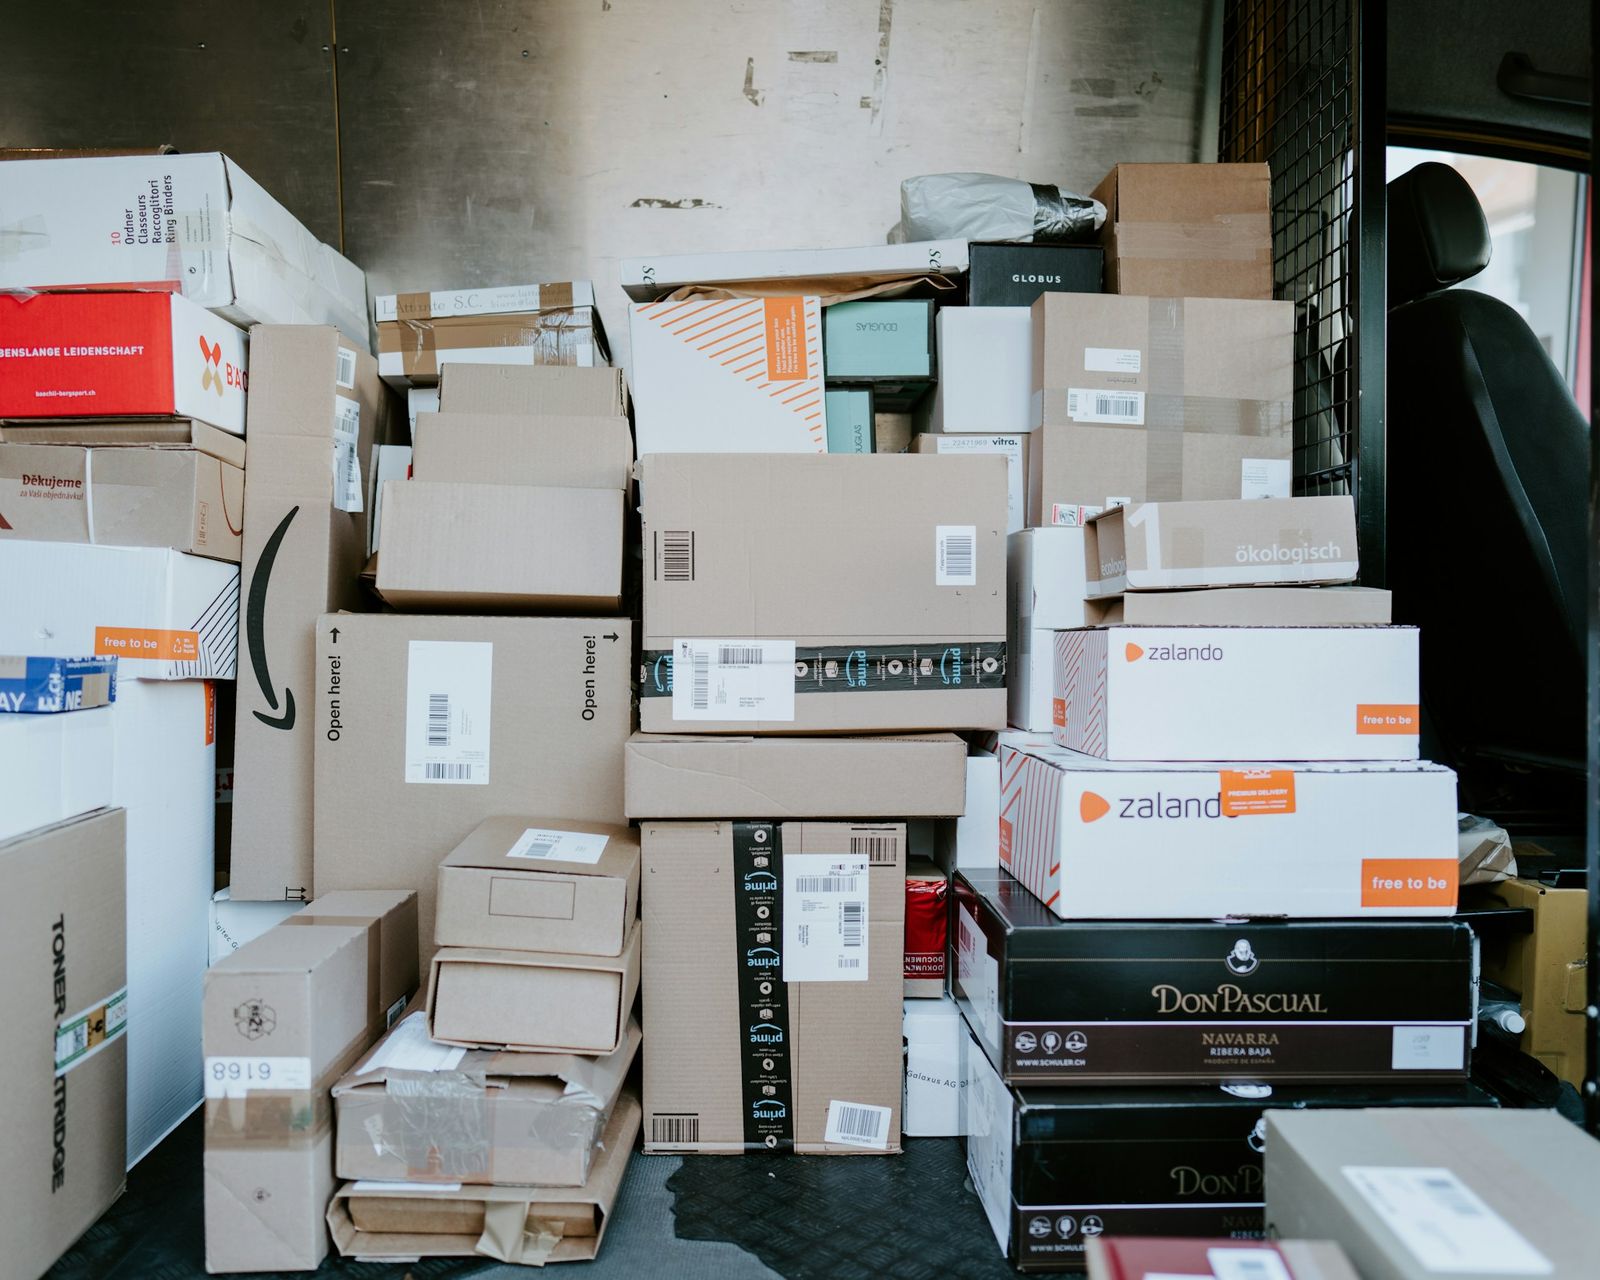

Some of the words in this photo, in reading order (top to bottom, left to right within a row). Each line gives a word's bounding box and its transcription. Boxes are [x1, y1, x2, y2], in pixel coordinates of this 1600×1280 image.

[162, 175, 173, 215] Binders
[138, 195, 148, 244] Classeurs
[148, 180, 162, 243] Raccoglitori
[124, 209, 134, 244] Ordner
[165, 220, 176, 243] Ring
[110, 232, 121, 245] 10
[1012, 274, 1062, 284] GLOBUS
[856, 322, 897, 332] DOUGLAS
[64, 346, 144, 356] LEIDENSCHAFT
[992, 437, 1018, 446] vitra.
[22, 474, 82, 489] Děkujeme
[1236, 541, 1341, 565] ökologisch
[104, 637, 126, 648] free
[130, 638, 140, 648] to
[144, 638, 158, 649] be
[1148, 643, 1223, 661] zalando
[583, 635, 596, 674] here!
[328, 655, 341, 695] here!
[857, 650, 867, 688] prime
[951, 648, 961, 685] prime
[582, 679, 597, 721] Open
[327, 699, 343, 742] Open
[1363, 715, 1383, 725] free
[1386, 716, 1396, 725] to
[1399, 715, 1412, 725] be
[1119, 791, 1239, 819] zaland
[744, 880, 777, 893] prime
[1372, 876, 1403, 890] free
[1407, 877, 1423, 890] to
[1428, 876, 1447, 890] be
[52, 914, 66, 1018] TONER
[747, 956, 780, 969] prime
[750, 1032, 783, 1045] prime
[1202, 1032, 1280, 1046] NAVARRA
[1210, 1047, 1246, 1056] RIBERA
[1248, 1047, 1272, 1056] BAJA
[212, 1062, 271, 1081] 6168
[1016, 1058, 1086, 1067] WWW.SCHULER.CH
[906, 1069, 941, 1085] Galaxus
[943, 1079, 957, 1089] AG
[52, 1026, 66, 1194] TRIDGE
[753, 1108, 786, 1121] prime
